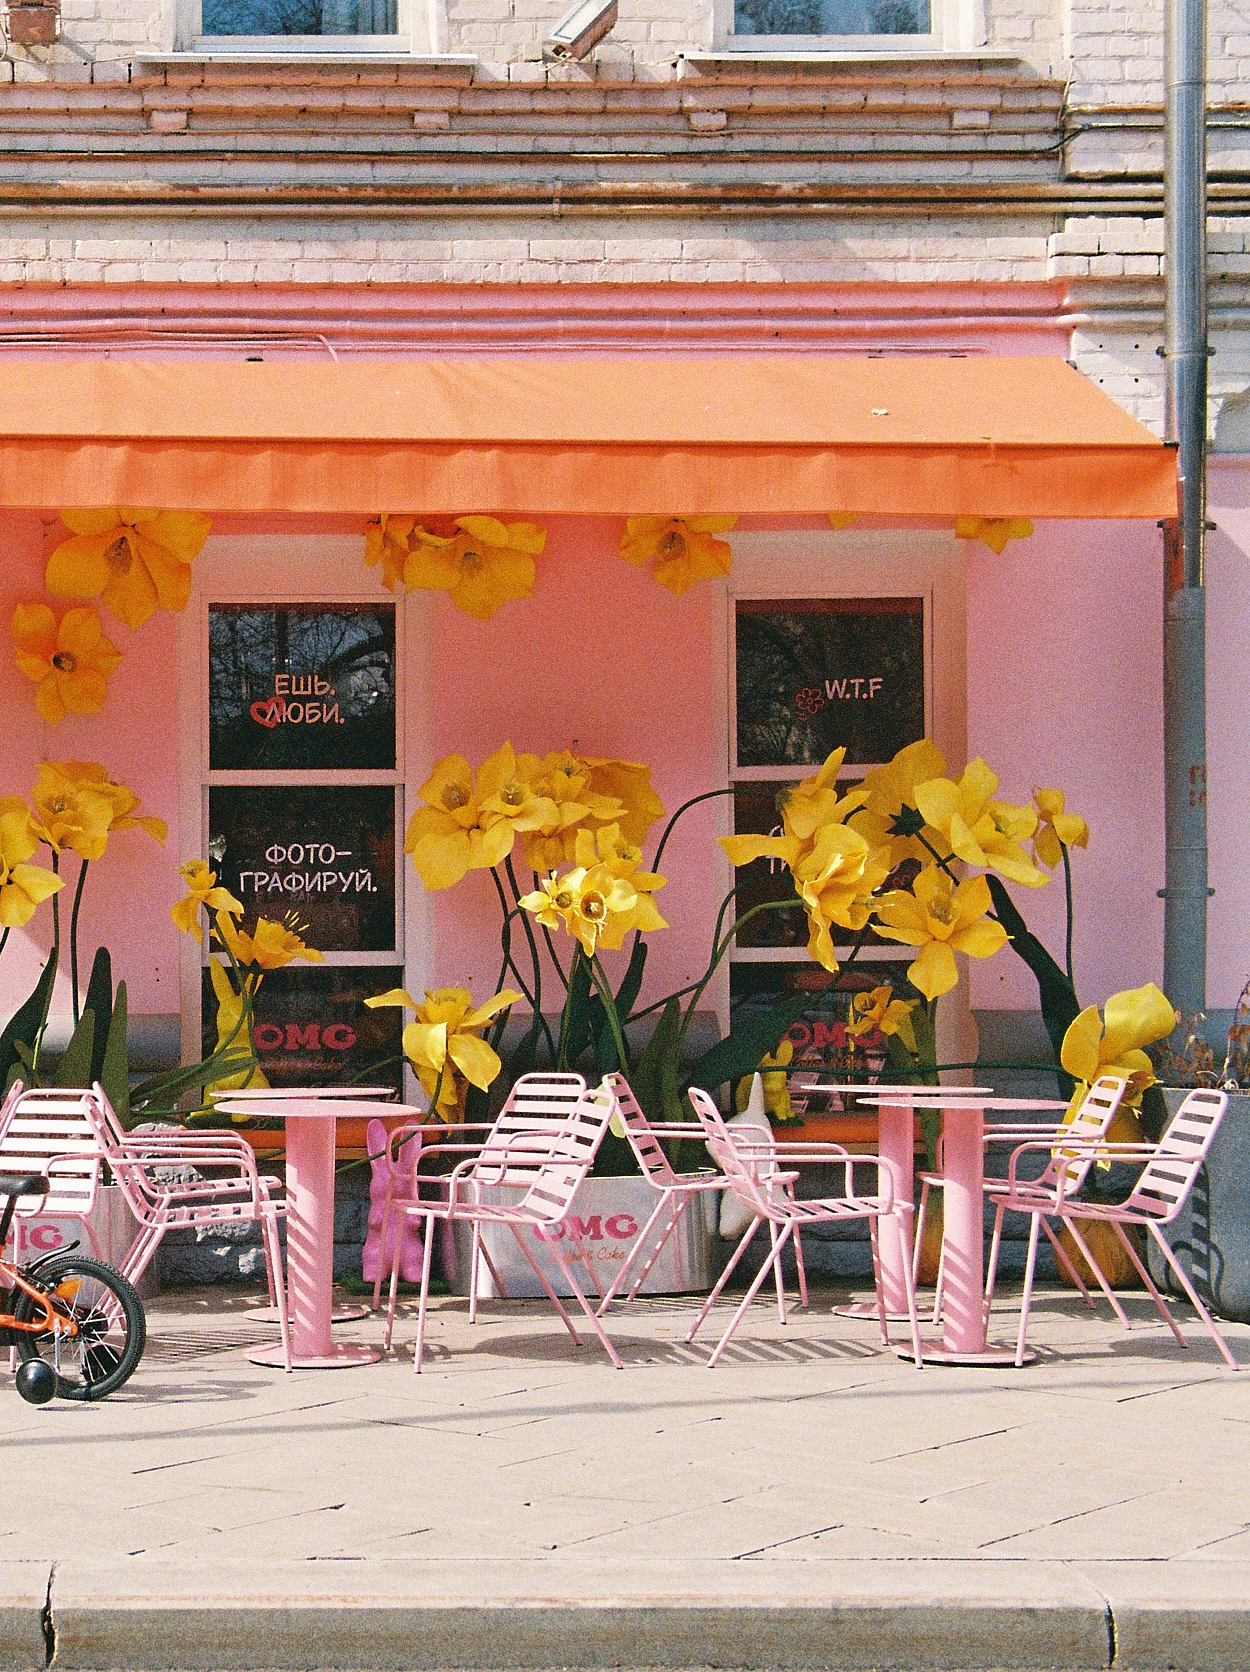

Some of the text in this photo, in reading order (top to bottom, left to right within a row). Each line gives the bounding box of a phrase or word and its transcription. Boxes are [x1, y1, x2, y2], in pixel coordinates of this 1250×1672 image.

[275, 673, 335, 695] ЕШЬ.
[825, 677, 883, 699] W.T.F
[264, 702, 345, 724] ЛЮБИ.
[239, 869, 378, 893] ГРАФИРУЙ.
[252, 1023, 357, 1050] OMG
